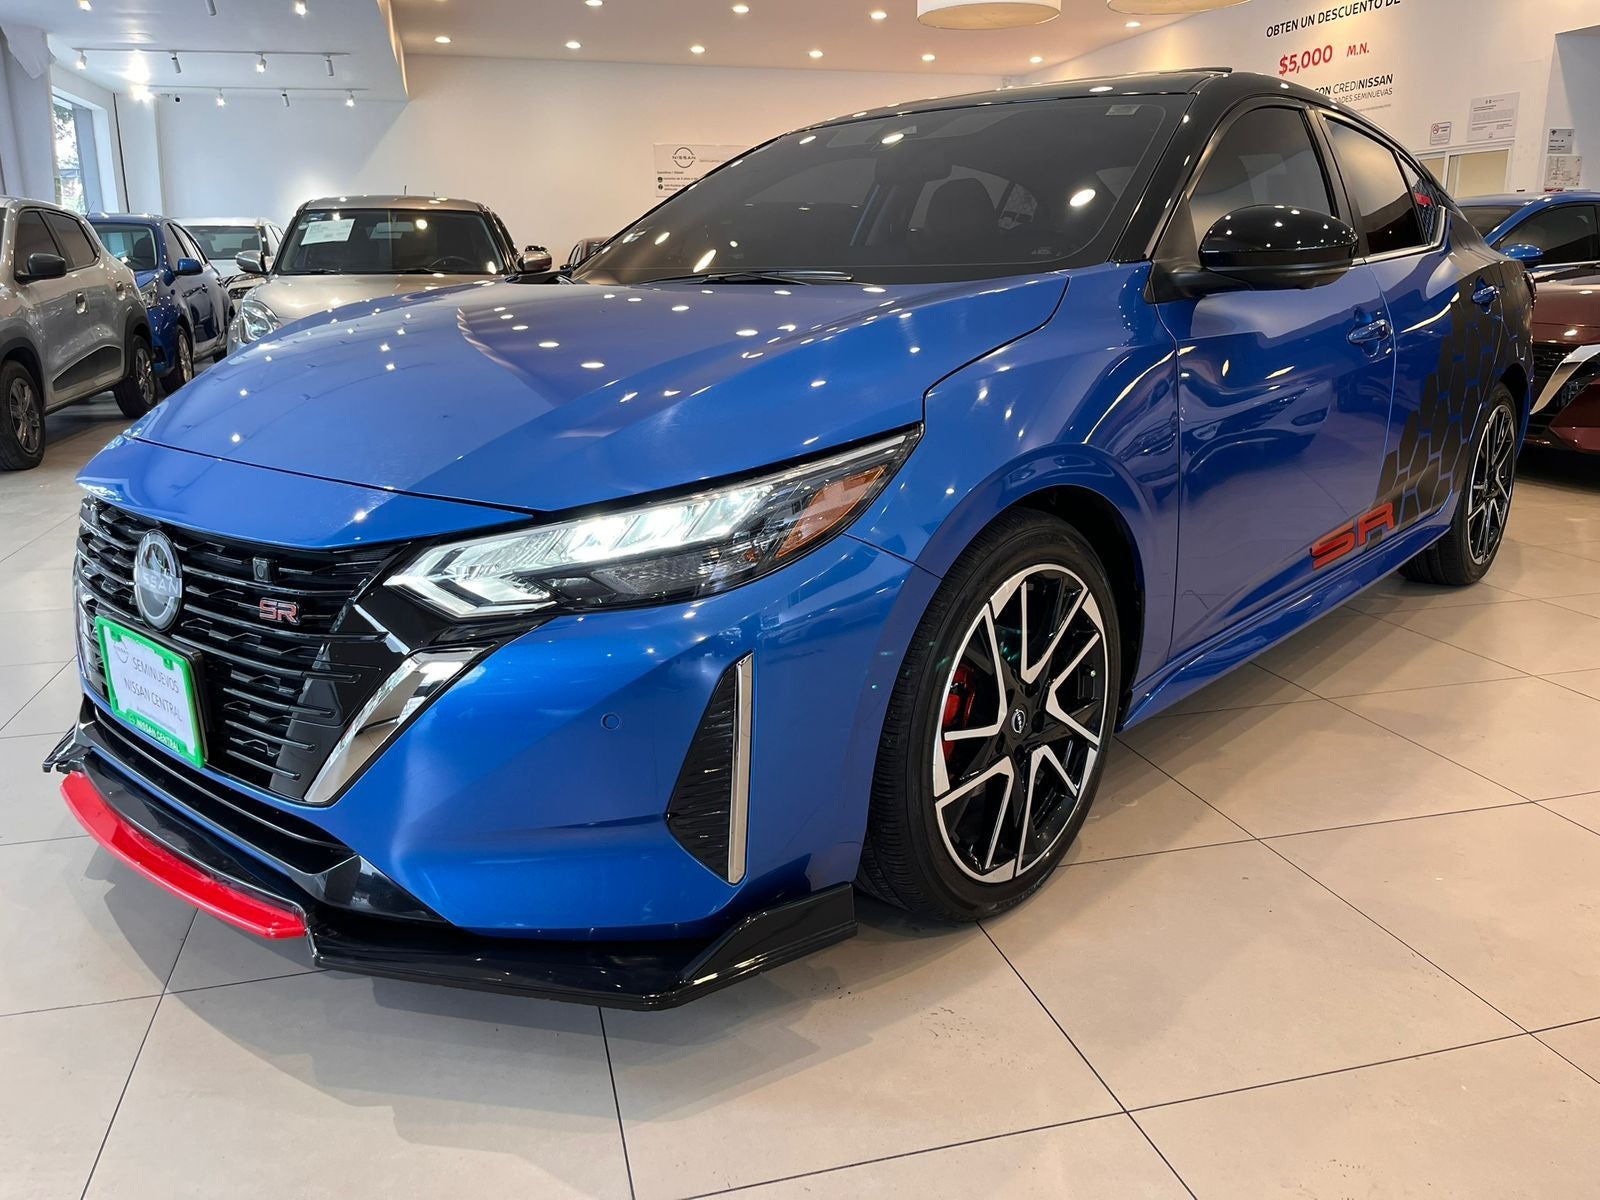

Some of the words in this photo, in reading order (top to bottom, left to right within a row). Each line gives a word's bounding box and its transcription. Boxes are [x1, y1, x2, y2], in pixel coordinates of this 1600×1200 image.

[1266, 19, 1299, 38] OBTEN
[1300, 14, 1315, 28] UN
[1317, 0, 1382, 24] DESCUENTO
[1279, 44, 1333, 76] $5,000
[1346, 42, 1370, 57] M.N.
[1333, 73, 1394, 94] CREDINISSAN
[1354, 88, 1393, 102] SEMINUEVAS
[1311, 502, 1395, 570] SR
[259, 597, 300, 625] SR
[132, 656, 180, 694] SEMINUEVOS
[123, 677, 151, 701] NISSAN
[151, 691, 183, 722] CENTRAL
